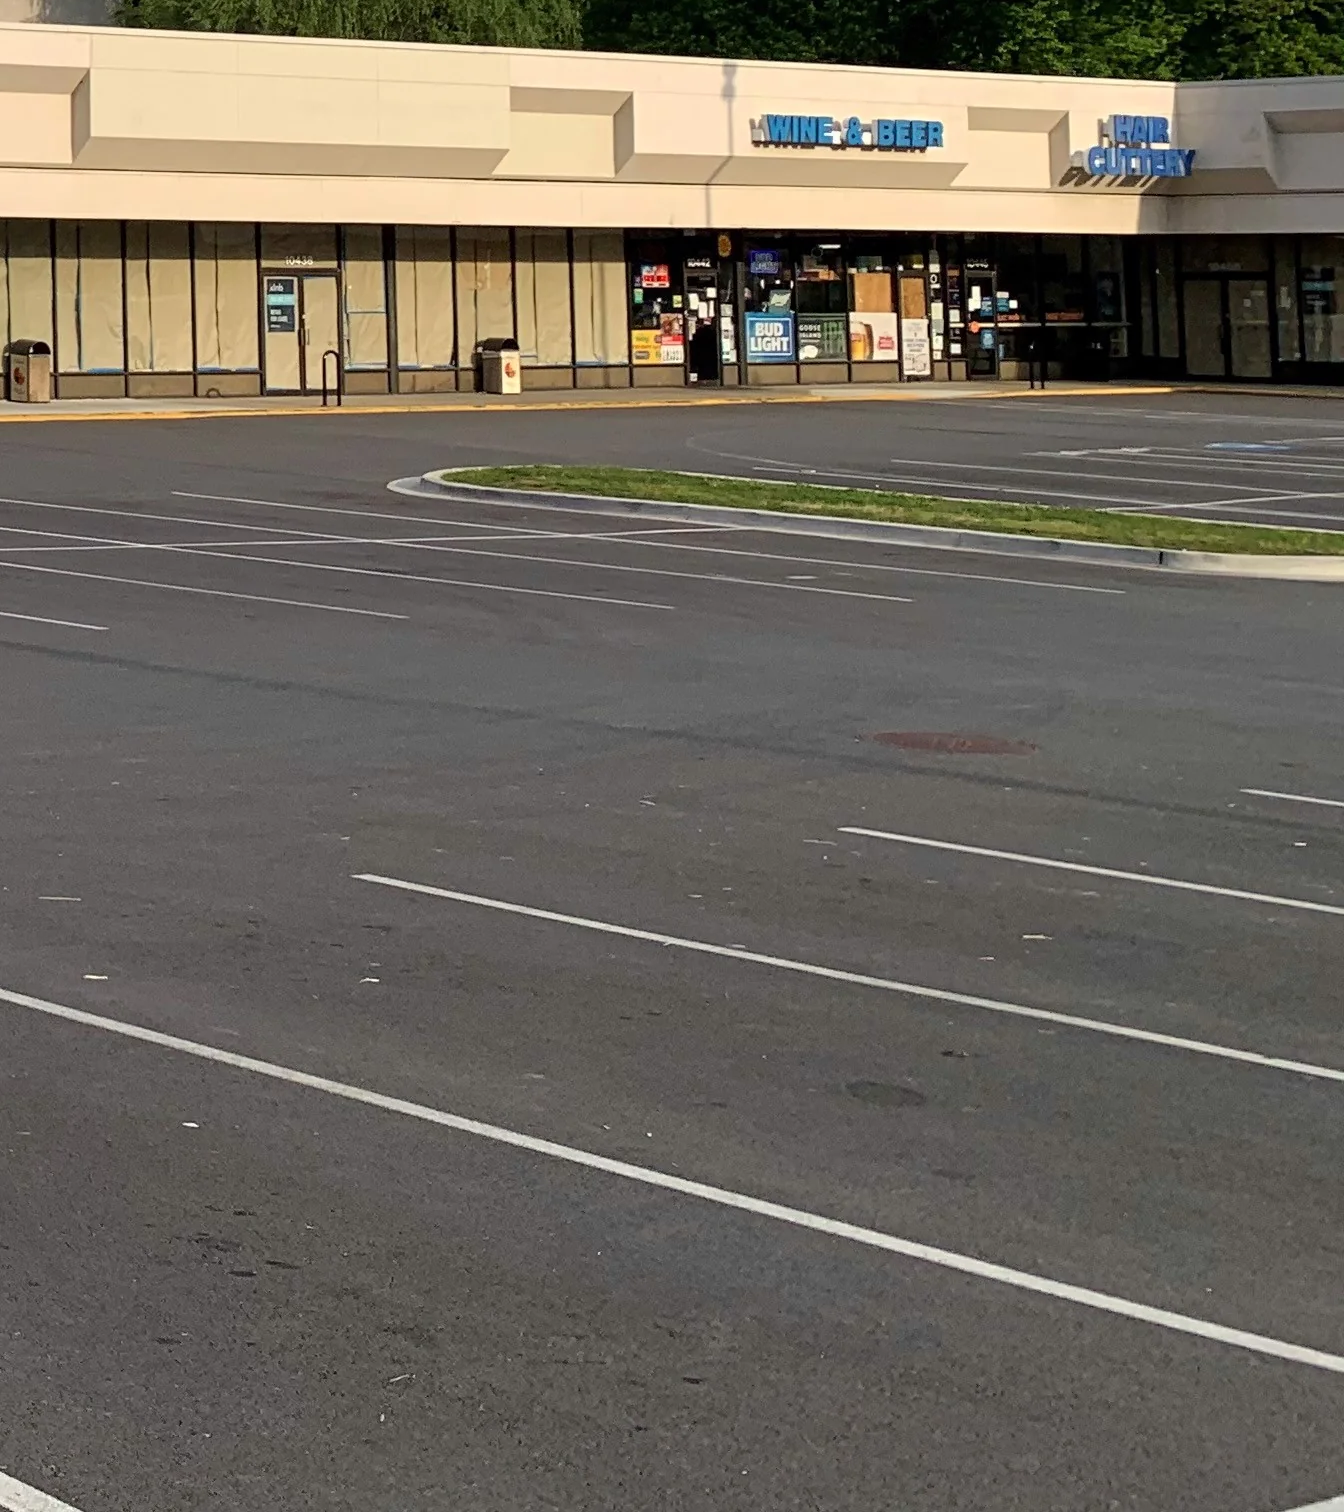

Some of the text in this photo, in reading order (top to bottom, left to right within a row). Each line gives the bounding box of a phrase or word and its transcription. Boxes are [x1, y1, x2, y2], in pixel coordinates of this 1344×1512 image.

[764, 114, 944, 148] WINE & BEER
[1111, 114, 1170, 143] HAIR
[1087, 146, 1196, 177] CUTTERY
[754, 322, 784, 337] BUD
[750, 337, 790, 352] LIGHT
